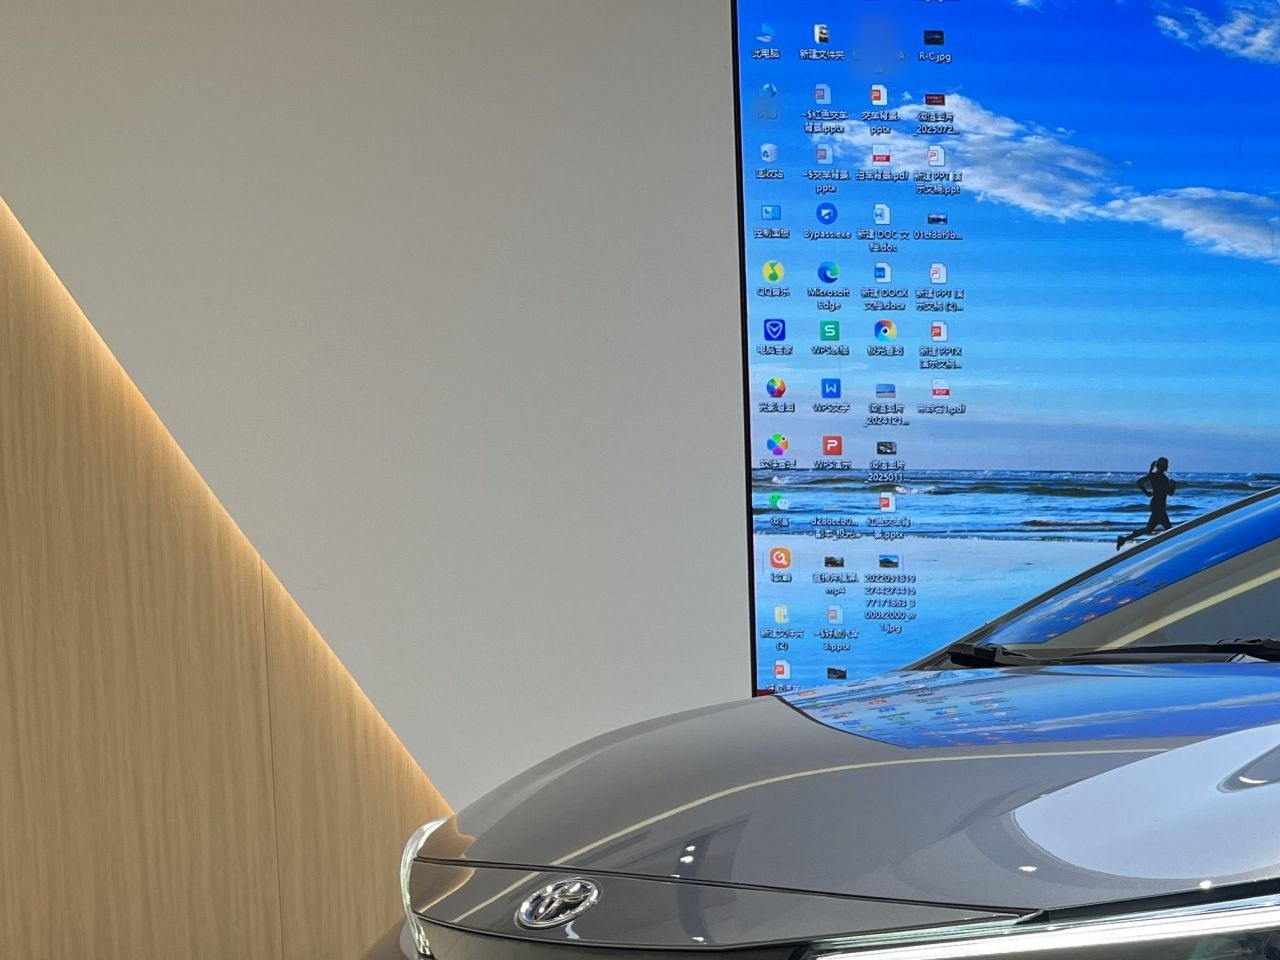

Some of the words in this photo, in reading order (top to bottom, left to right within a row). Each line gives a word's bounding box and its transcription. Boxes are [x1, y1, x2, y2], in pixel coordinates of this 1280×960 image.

[919, 51, 952, 63] R-C.jpg
[808, 287, 851, 297] Microsoft
[817, 300, 841, 312] Edge
